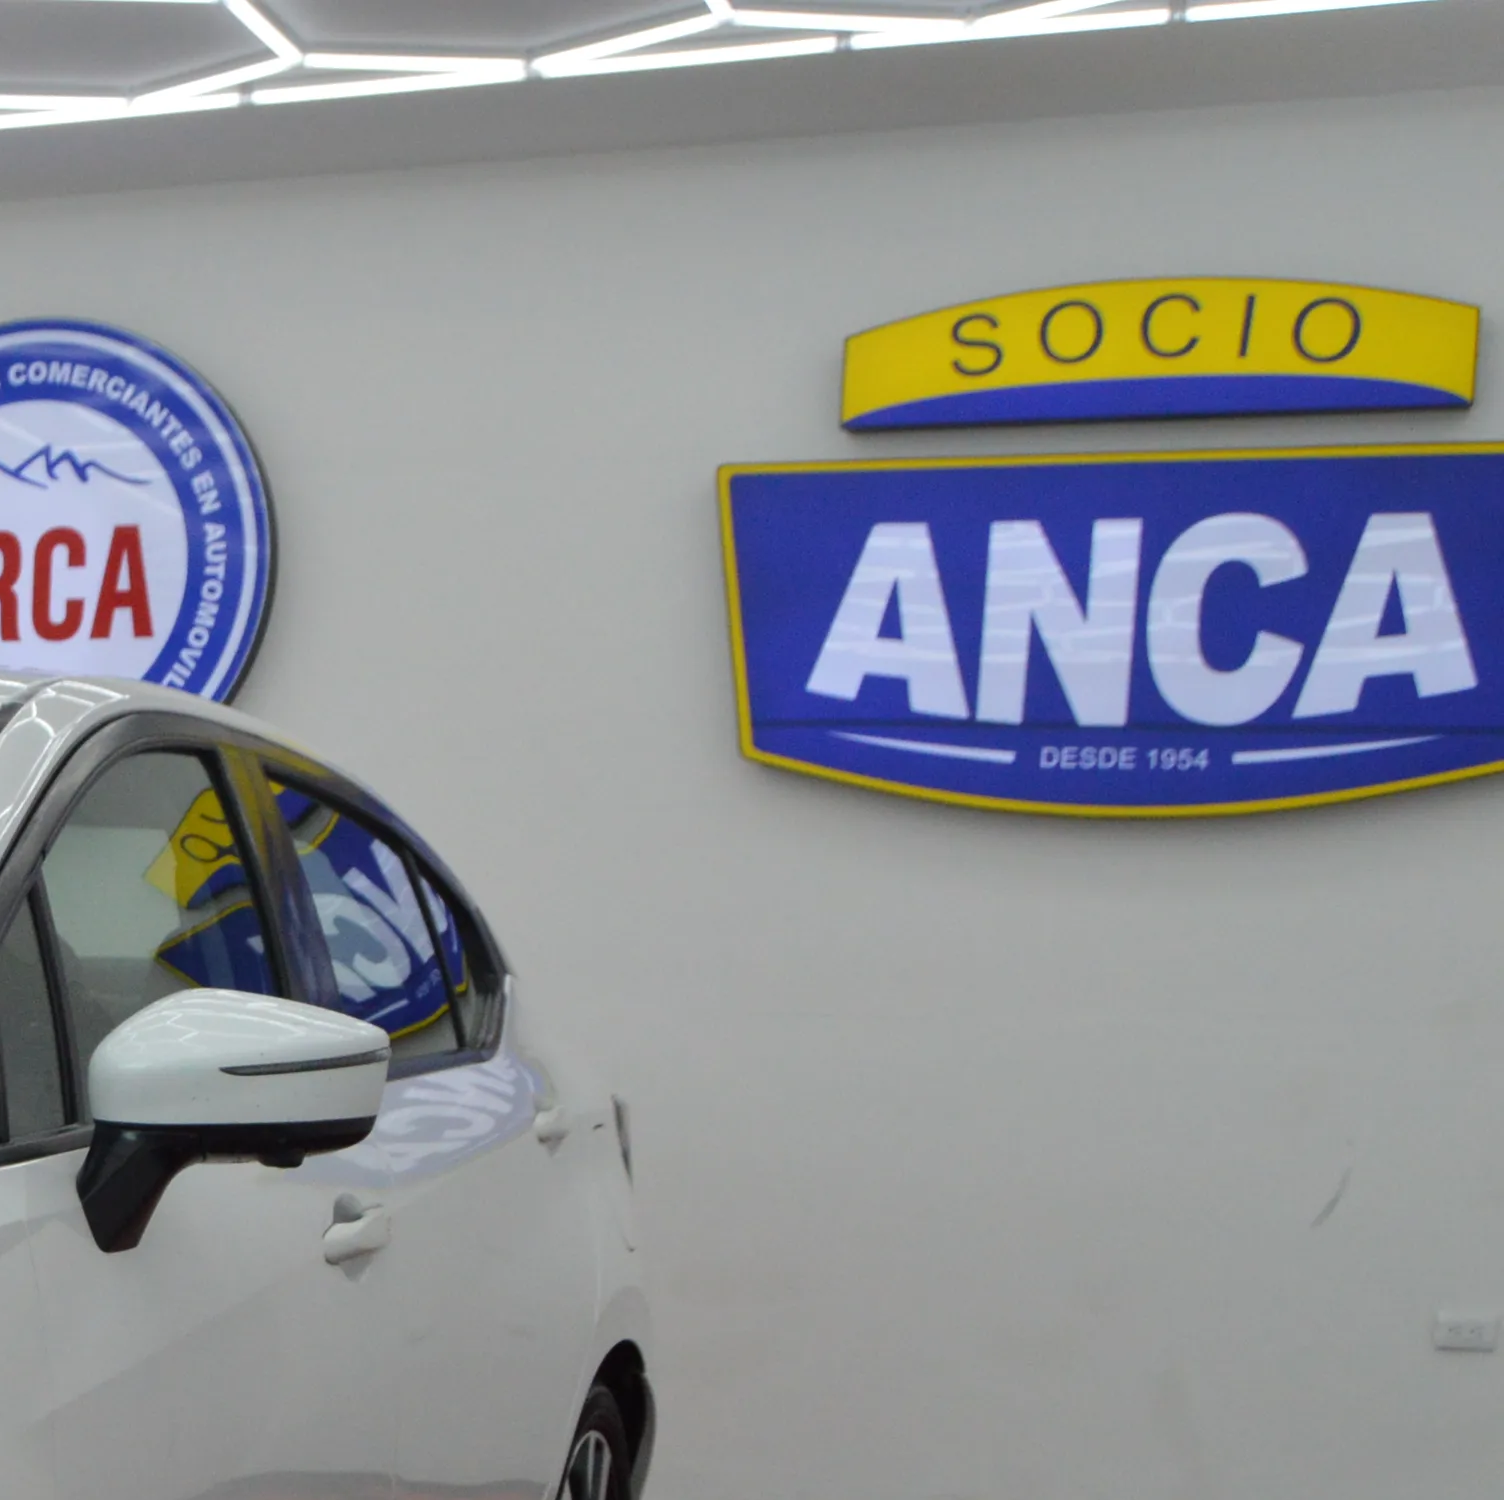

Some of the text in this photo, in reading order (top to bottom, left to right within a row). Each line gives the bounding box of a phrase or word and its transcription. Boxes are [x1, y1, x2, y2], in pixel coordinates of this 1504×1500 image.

[951, 294, 1363, 376] SOCIO
[8, 361, 202, 470] COMERCIANTES
[191, 469, 221, 515] EN
[805, 512, 1480, 728] ANCA
[1039, 745, 1210, 771] DESDE 1954
